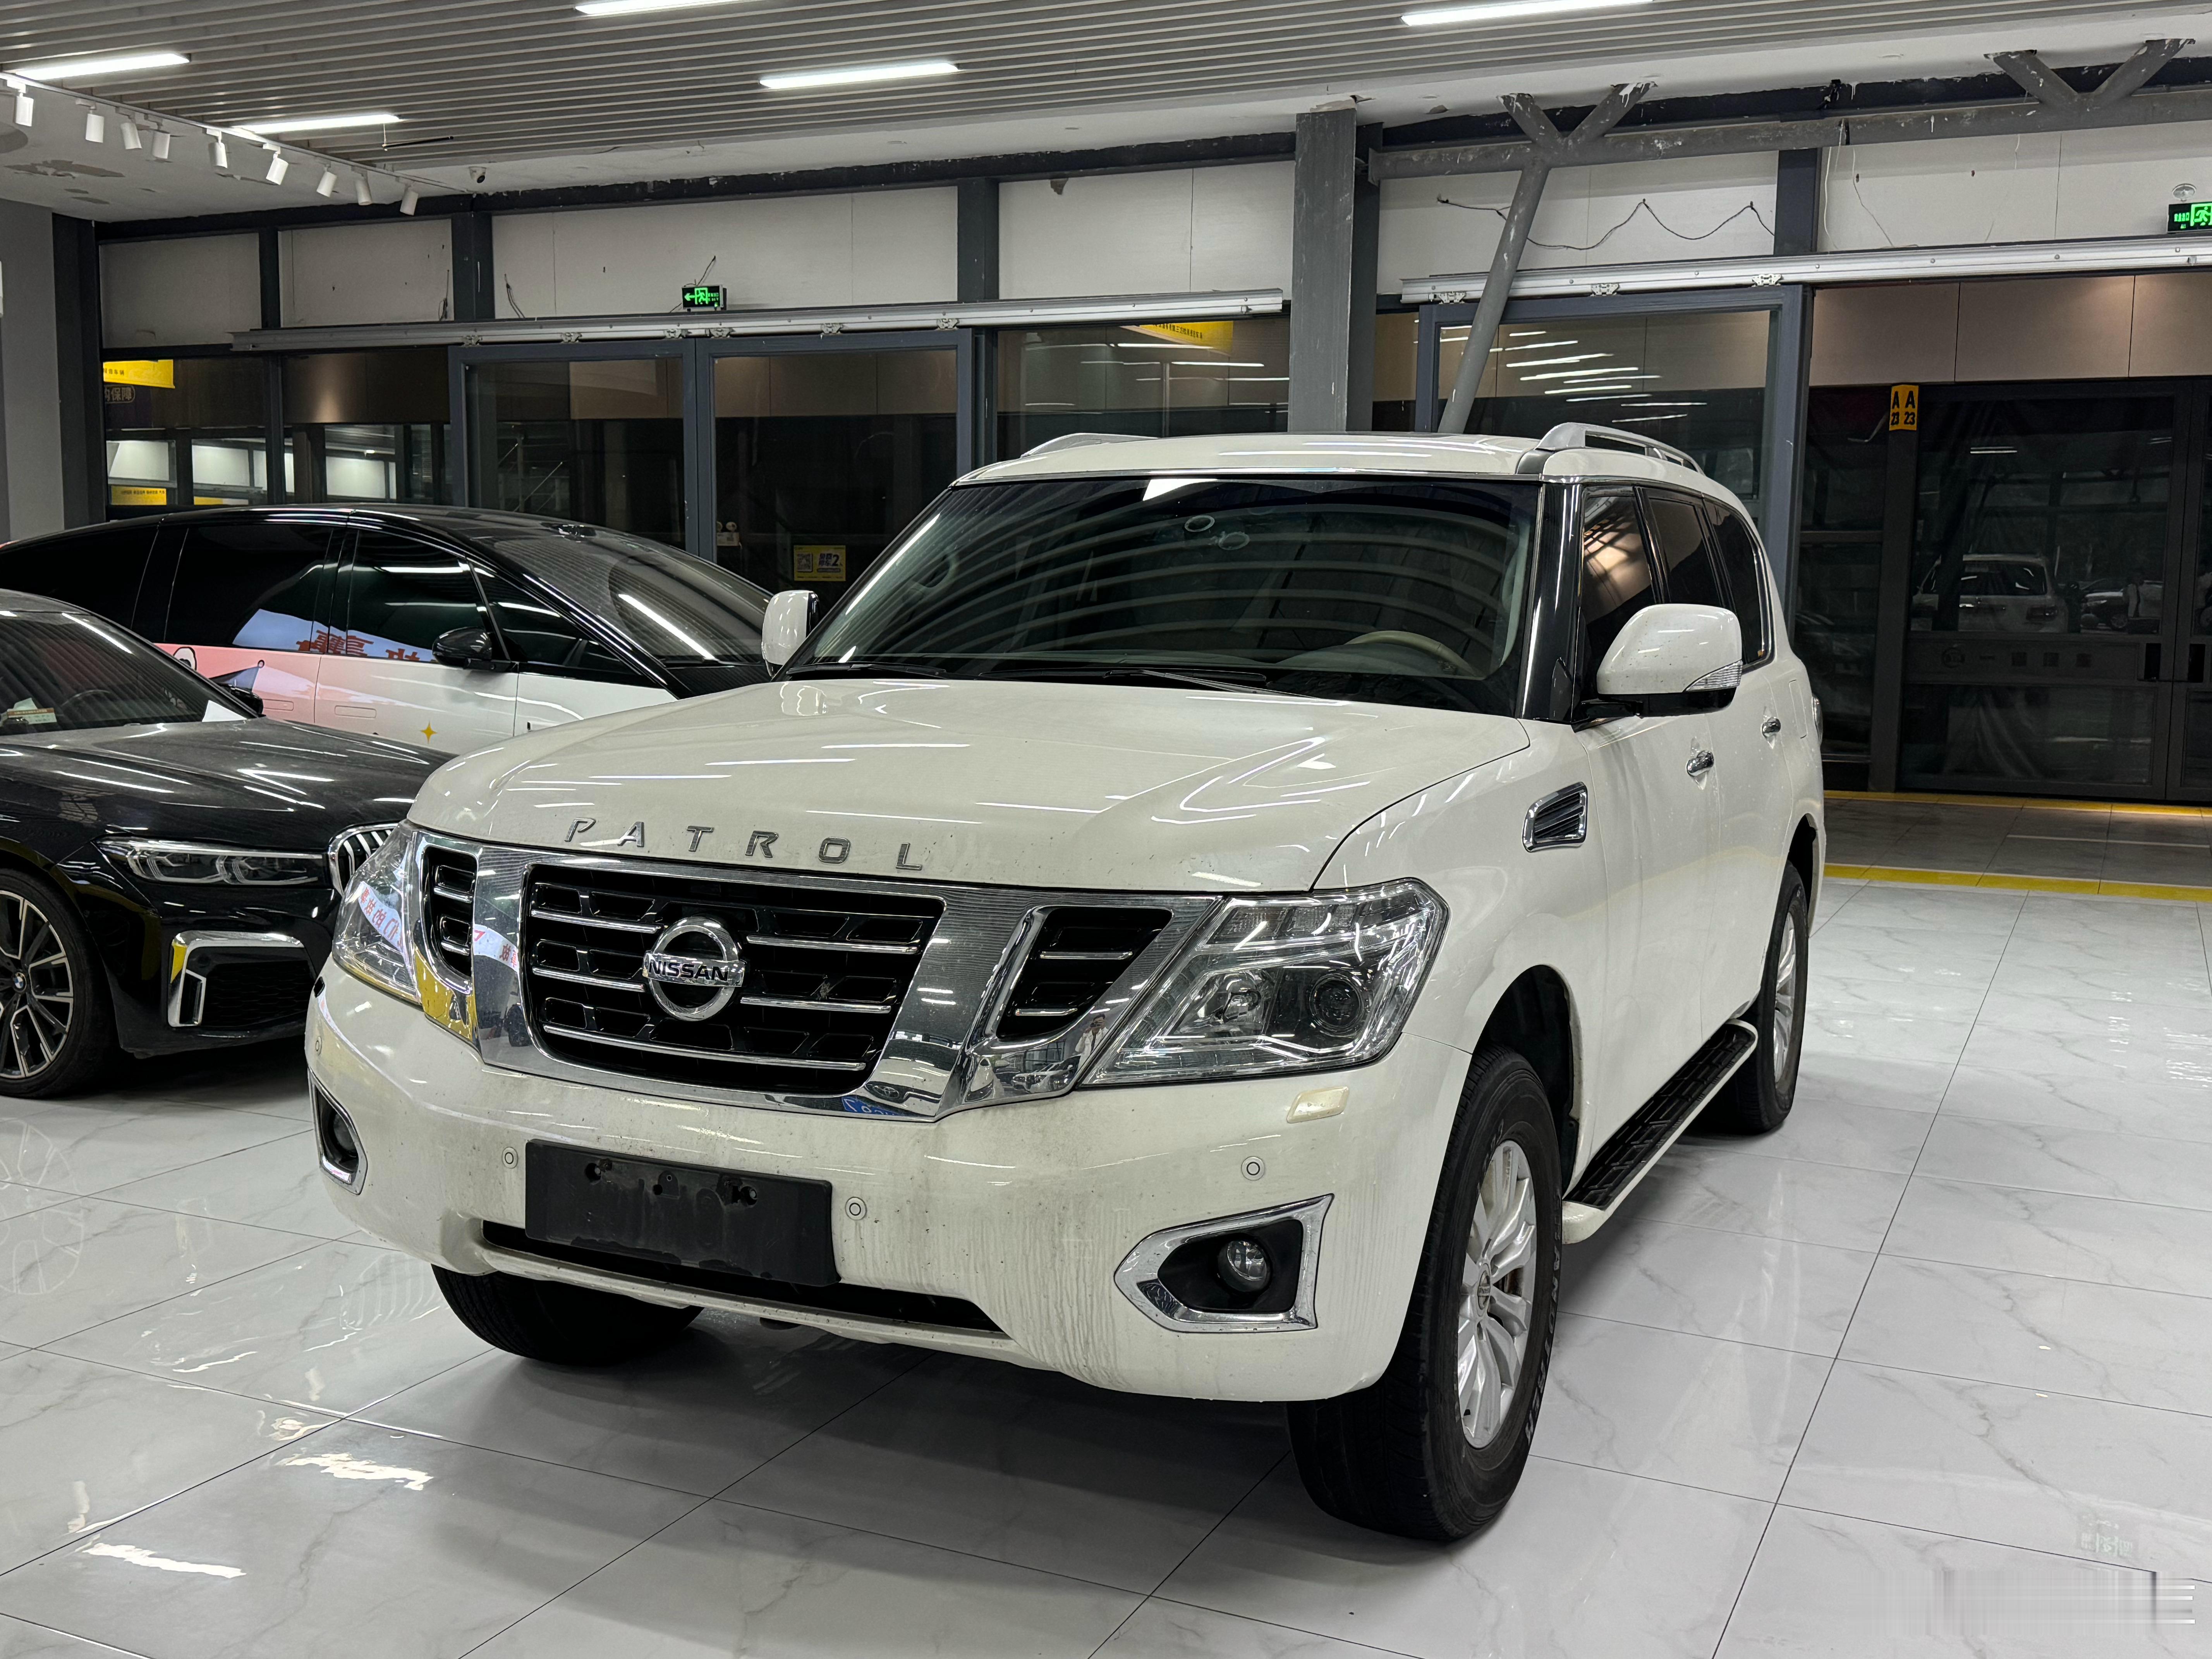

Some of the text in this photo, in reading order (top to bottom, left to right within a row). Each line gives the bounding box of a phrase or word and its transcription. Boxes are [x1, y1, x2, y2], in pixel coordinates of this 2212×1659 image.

[1905, 390, 1915, 409] A
[1904, 412, 1915, 425] 23
[563, 817, 923, 871] PATROL
[647, 958, 730, 982] NISSAN
